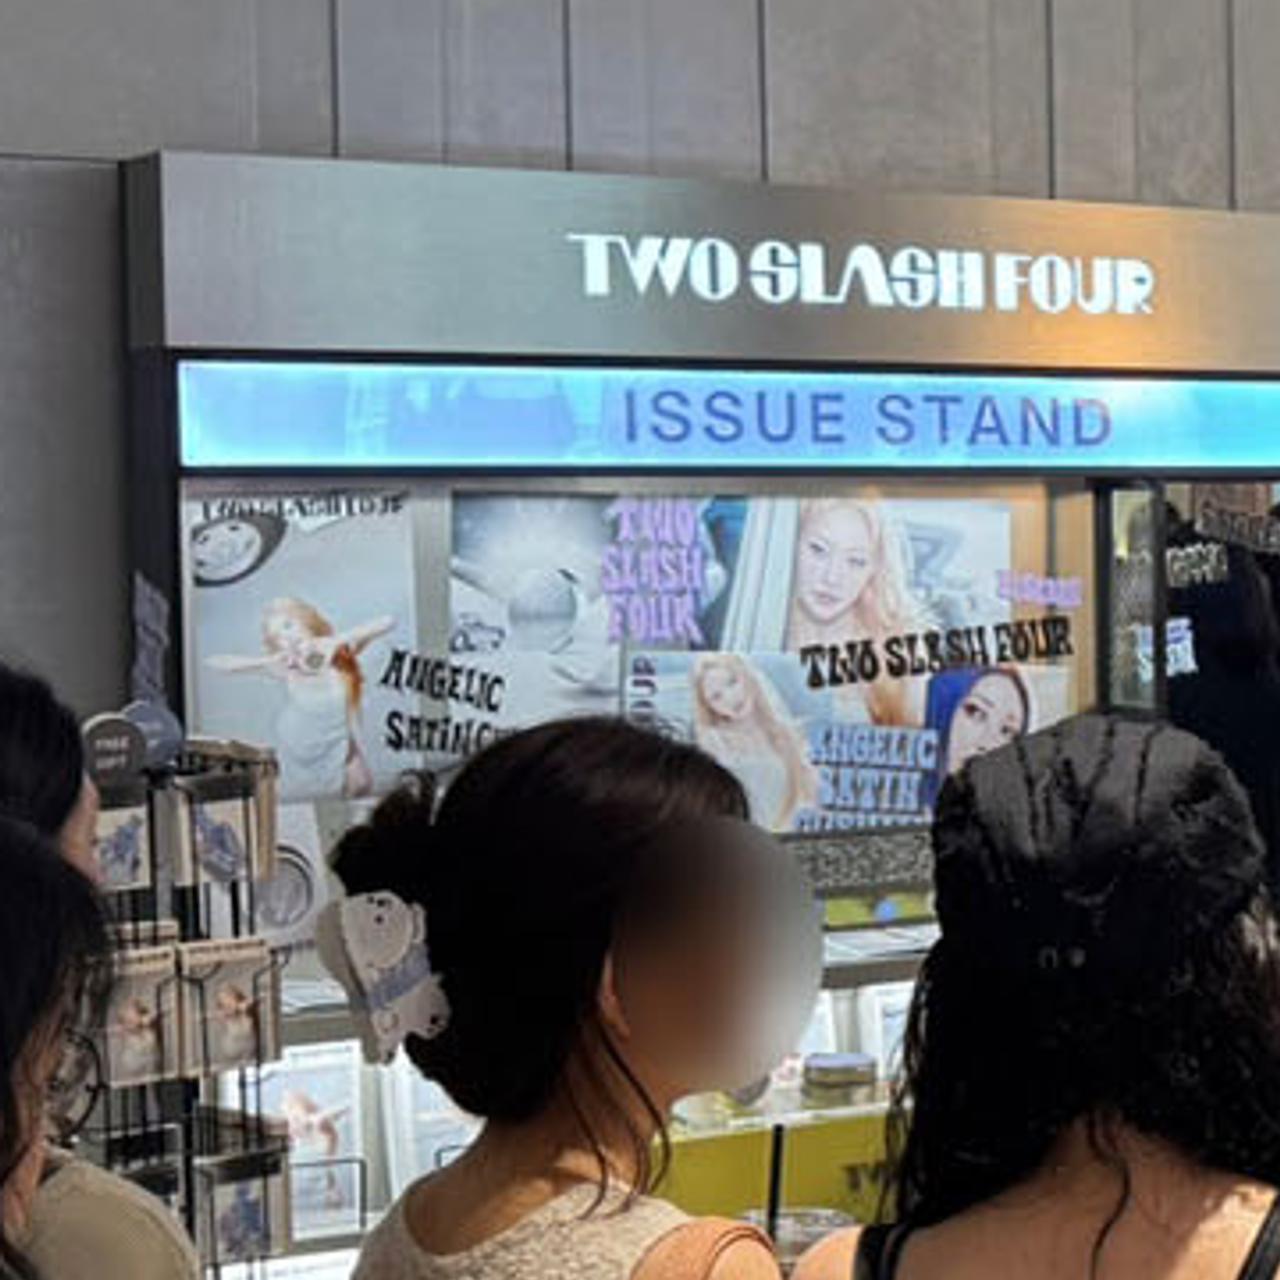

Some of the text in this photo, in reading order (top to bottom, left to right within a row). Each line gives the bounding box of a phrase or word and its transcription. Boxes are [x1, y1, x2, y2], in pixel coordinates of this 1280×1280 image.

[566, 232, 1155, 315] TWO SLASH FOUR
[624, 389, 1113, 447] ISSUE STAND
[379, 648, 506, 713] ANGELIC
[800, 615, 1074, 690] TWO SLASH FOUR
[808, 723, 939, 770] ANGELIC
